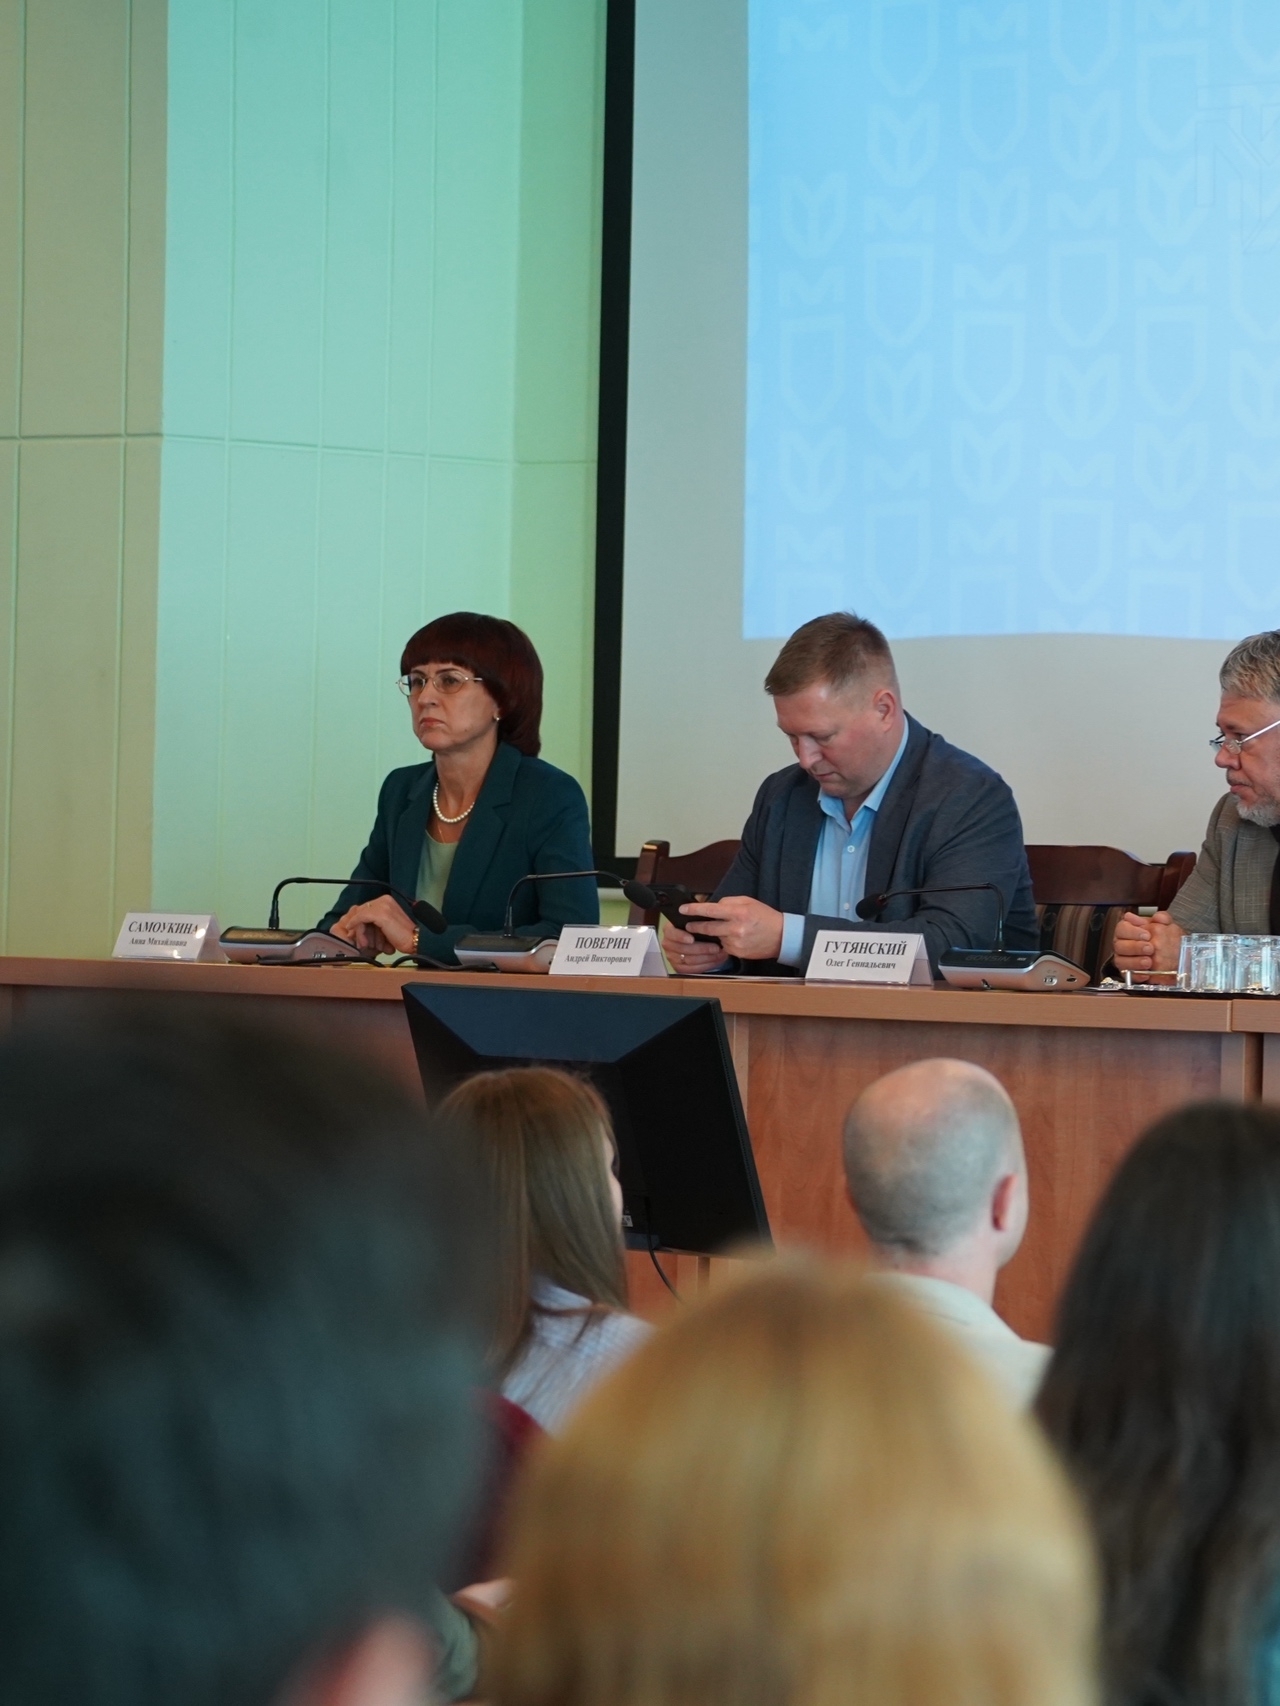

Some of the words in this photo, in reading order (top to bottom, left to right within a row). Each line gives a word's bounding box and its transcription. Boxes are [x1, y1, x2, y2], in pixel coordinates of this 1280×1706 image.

[128, 920, 200, 935] САМОУКИНА
[129, 937, 146, 945] Анна
[147, 937, 188, 947] Михайловна
[575, 937, 631, 950] ПОВЕРИН
[824, 940, 907, 956] ГУТЯНСКИЙ
[565, 954, 590, 965] Андрей
[590, 954, 632, 965] Викторович
[825, 958, 845, 967] Олег
[846, 959, 897, 970] Геннадьевич
